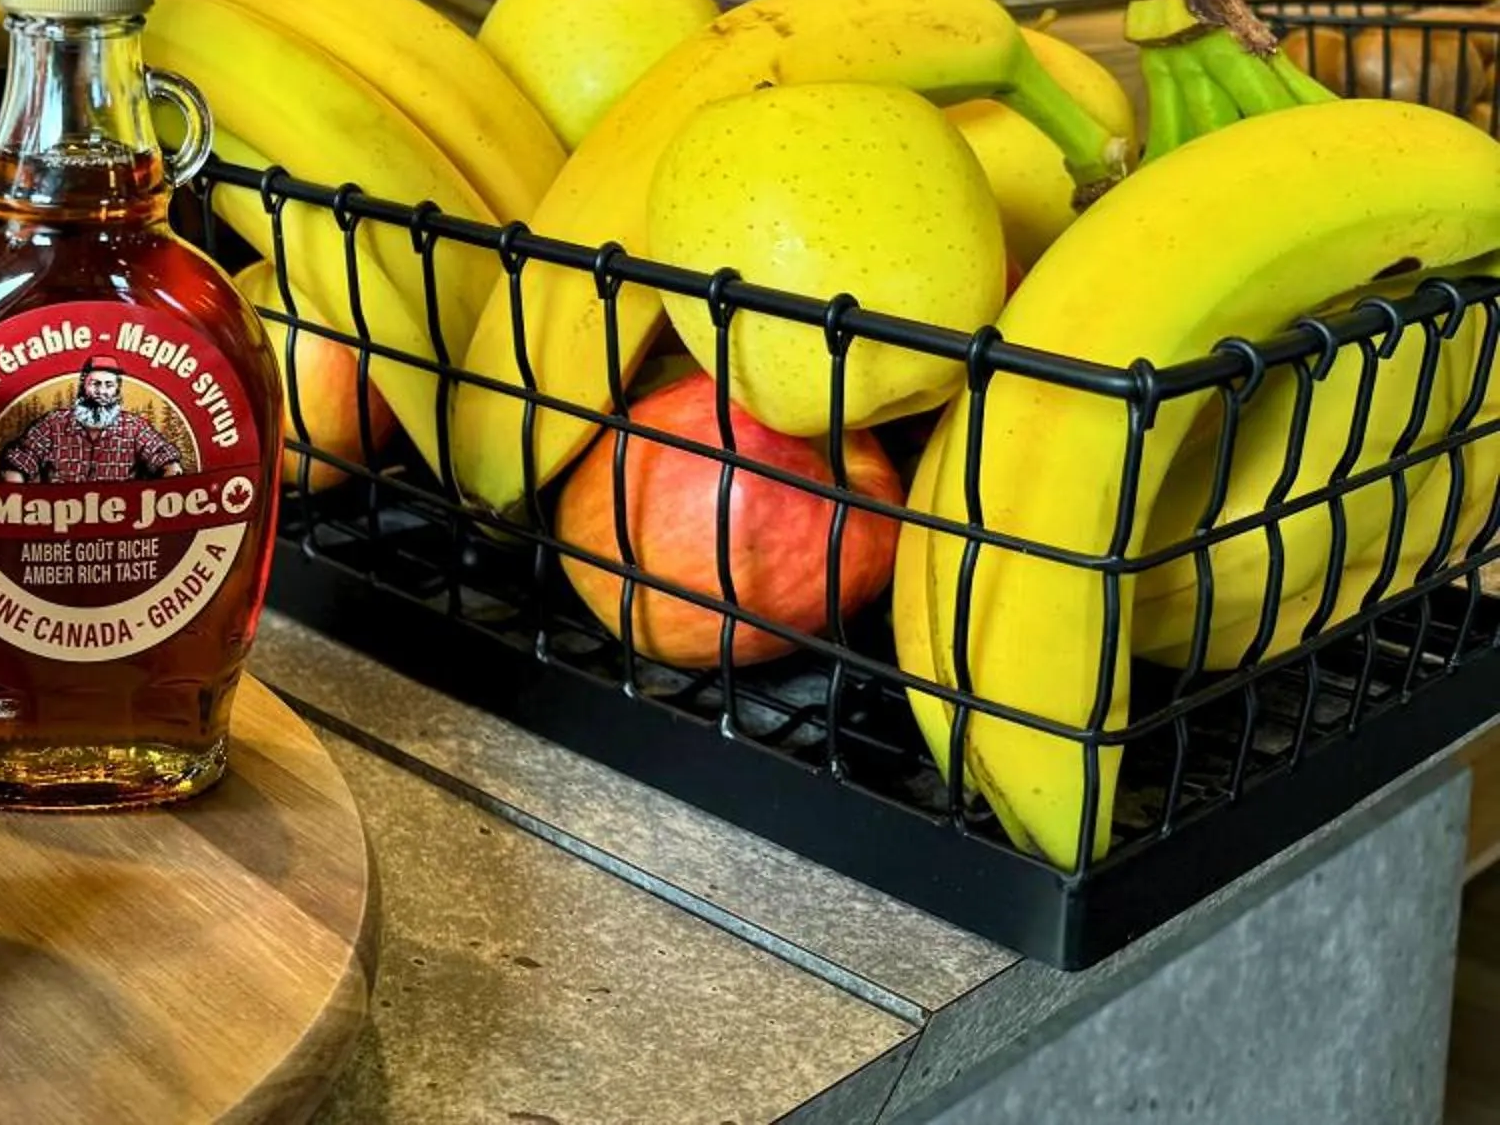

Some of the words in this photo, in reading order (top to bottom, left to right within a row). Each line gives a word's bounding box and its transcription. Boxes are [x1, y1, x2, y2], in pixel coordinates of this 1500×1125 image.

[116, 321, 200, 379] Maple
[191, 372, 240, 449] syrup
[21, 539, 73, 563] AMBRÉ
[75, 537, 114, 562] GOÛT
[117, 538, 160, 560] RICHE
[23, 565, 74, 586] AMBER
[77, 563, 111, 584] RICH
[115, 561, 158, 583] TASTE
[33, 615, 133, 649] CANADA
[146, 560, 215, 629] GRADE
[207, 542, 228, 562] A
